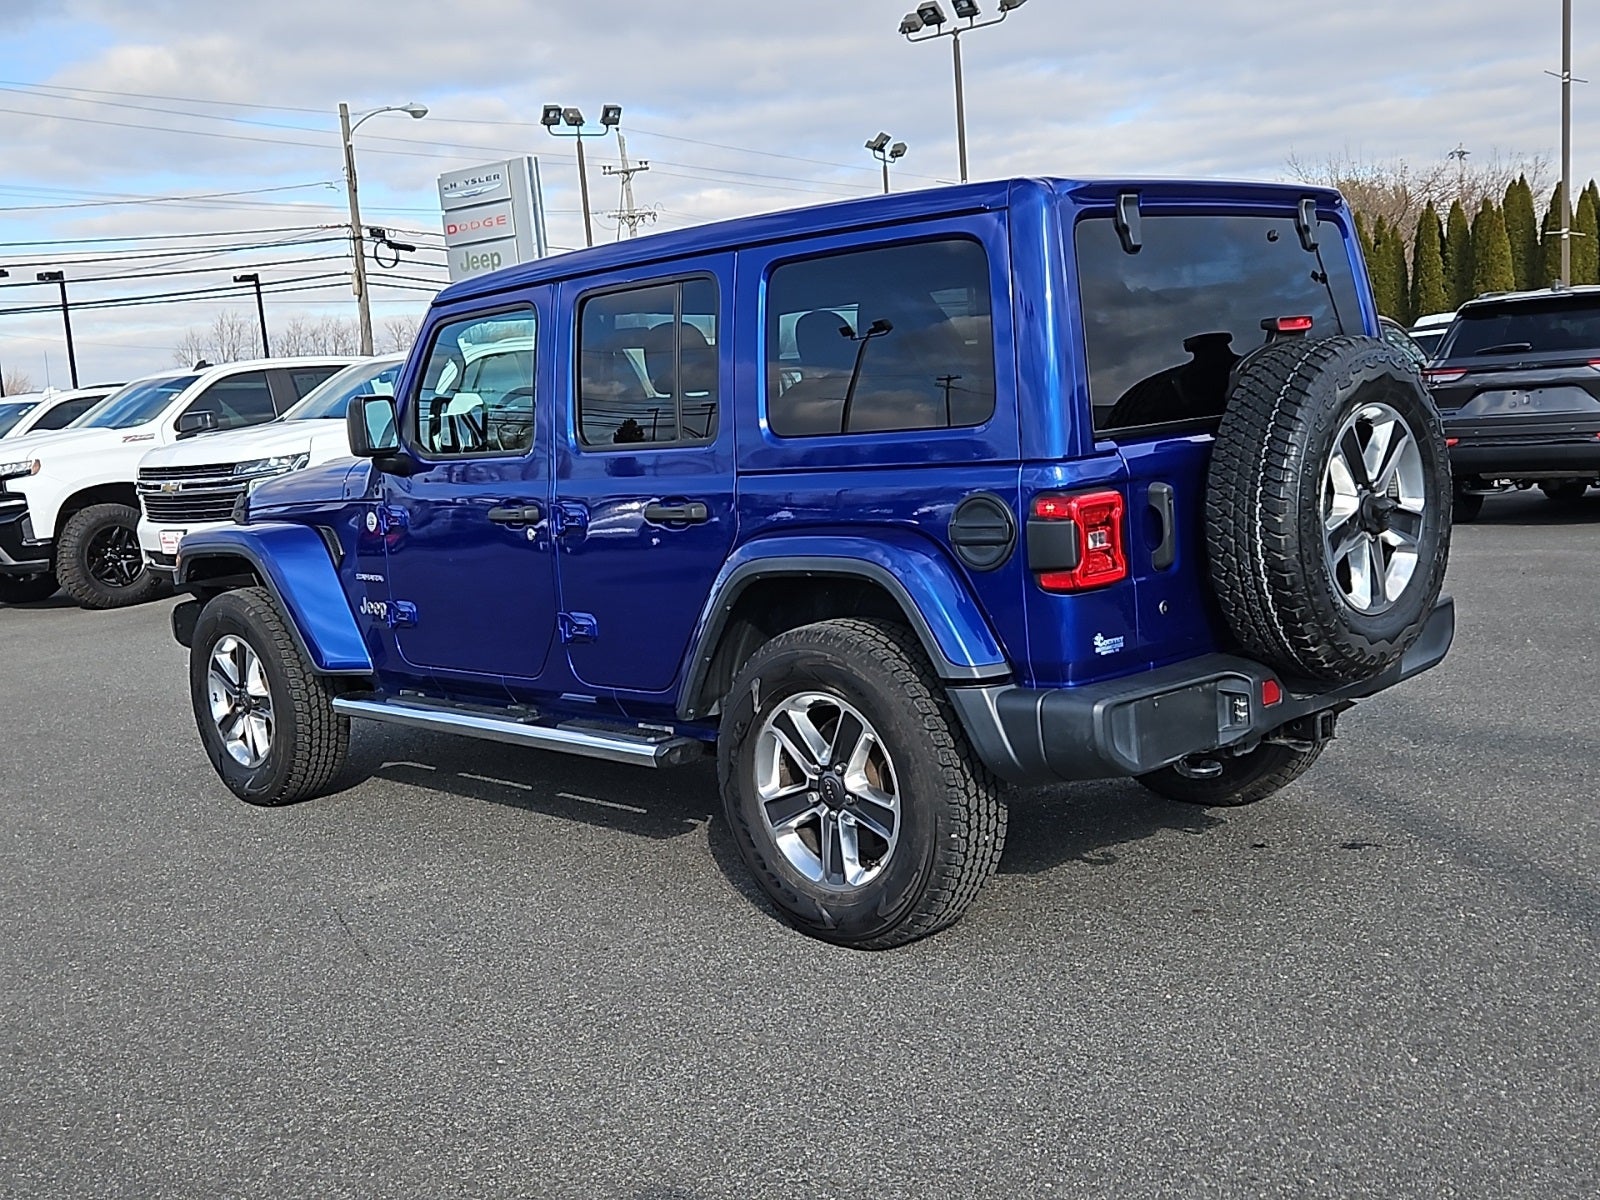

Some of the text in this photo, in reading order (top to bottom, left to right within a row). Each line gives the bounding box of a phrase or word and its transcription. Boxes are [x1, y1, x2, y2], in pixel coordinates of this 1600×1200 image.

[447, 215, 506, 235] DODGE
[461, 251, 501, 272] Jeep
[360, 597, 387, 619] Jeep
